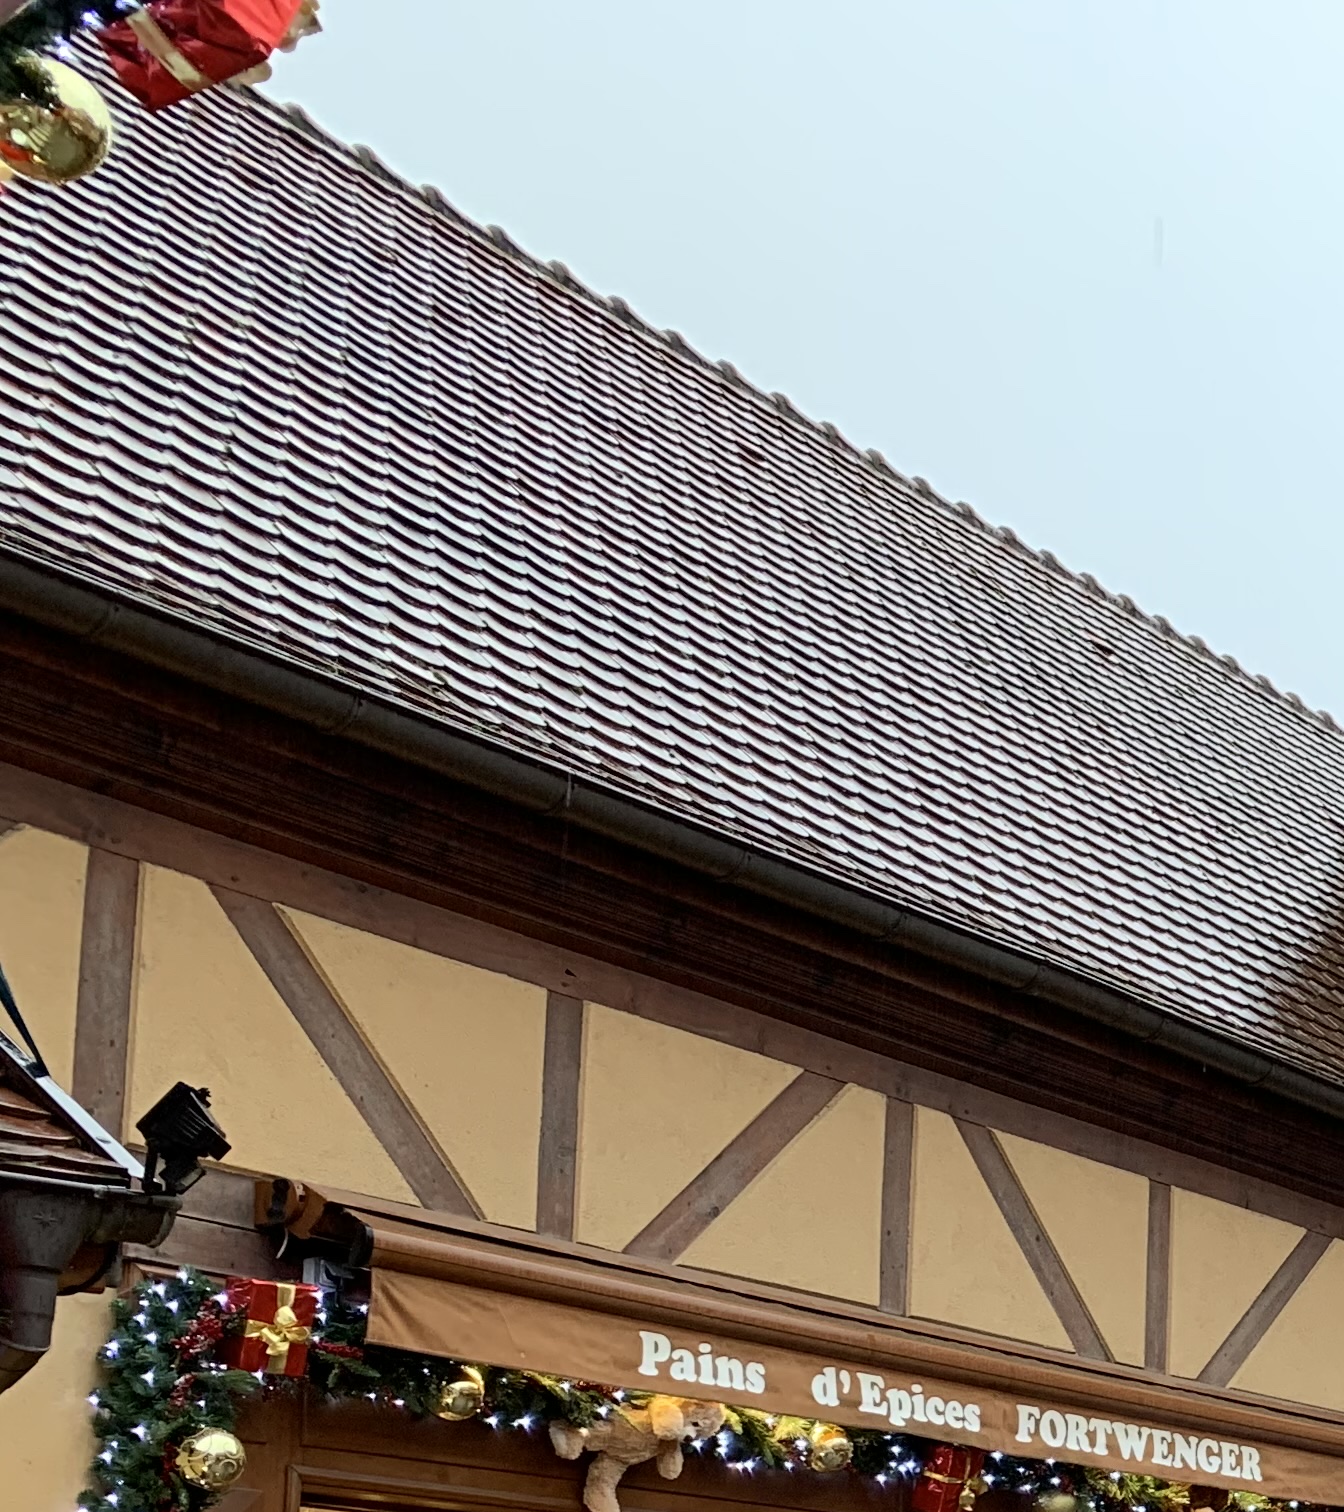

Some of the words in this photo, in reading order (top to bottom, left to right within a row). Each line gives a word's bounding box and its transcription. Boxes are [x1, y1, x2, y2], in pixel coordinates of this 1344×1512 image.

[638, 1331, 765, 1394] Pains
[811, 1366, 980, 1433] d'Epices
[1015, 1404, 1263, 1482] FORTWENGER
